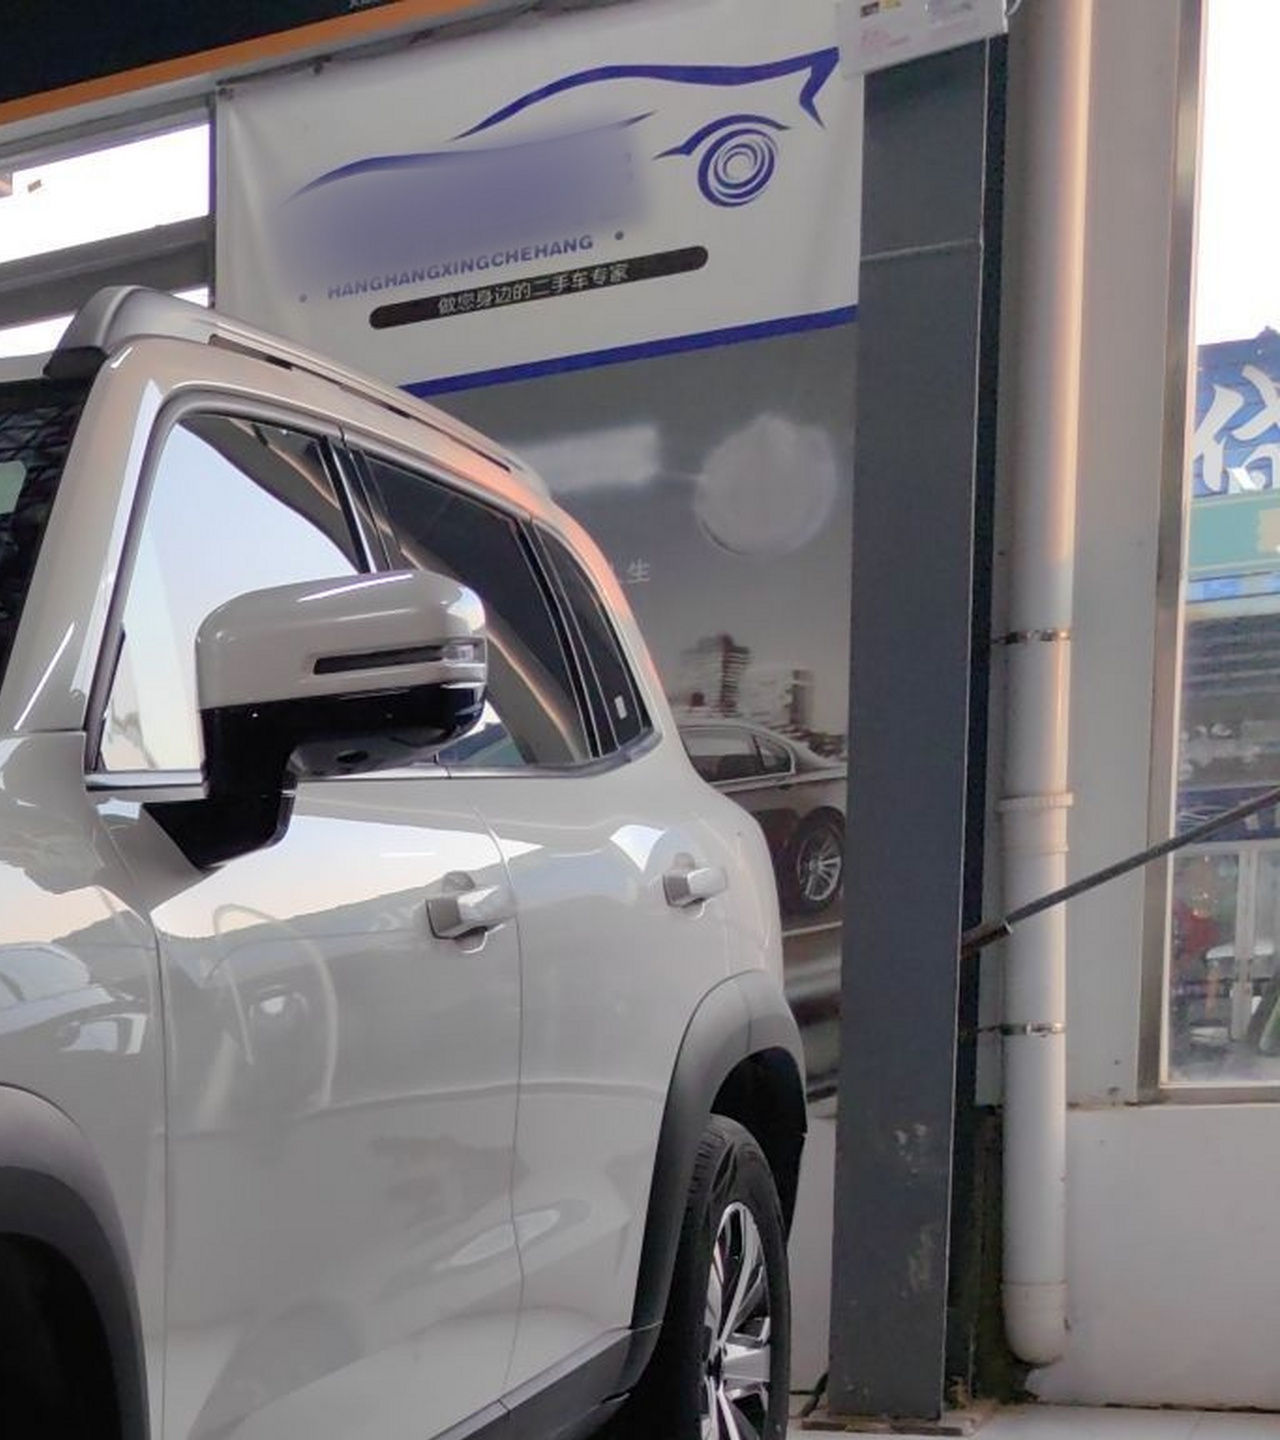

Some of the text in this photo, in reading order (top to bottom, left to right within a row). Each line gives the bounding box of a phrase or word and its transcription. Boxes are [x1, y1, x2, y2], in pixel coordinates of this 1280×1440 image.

[327, 234, 594, 300] HANGHANGXINGCHEHANG
[438, 262, 630, 315] 做您身边的二手车专家
